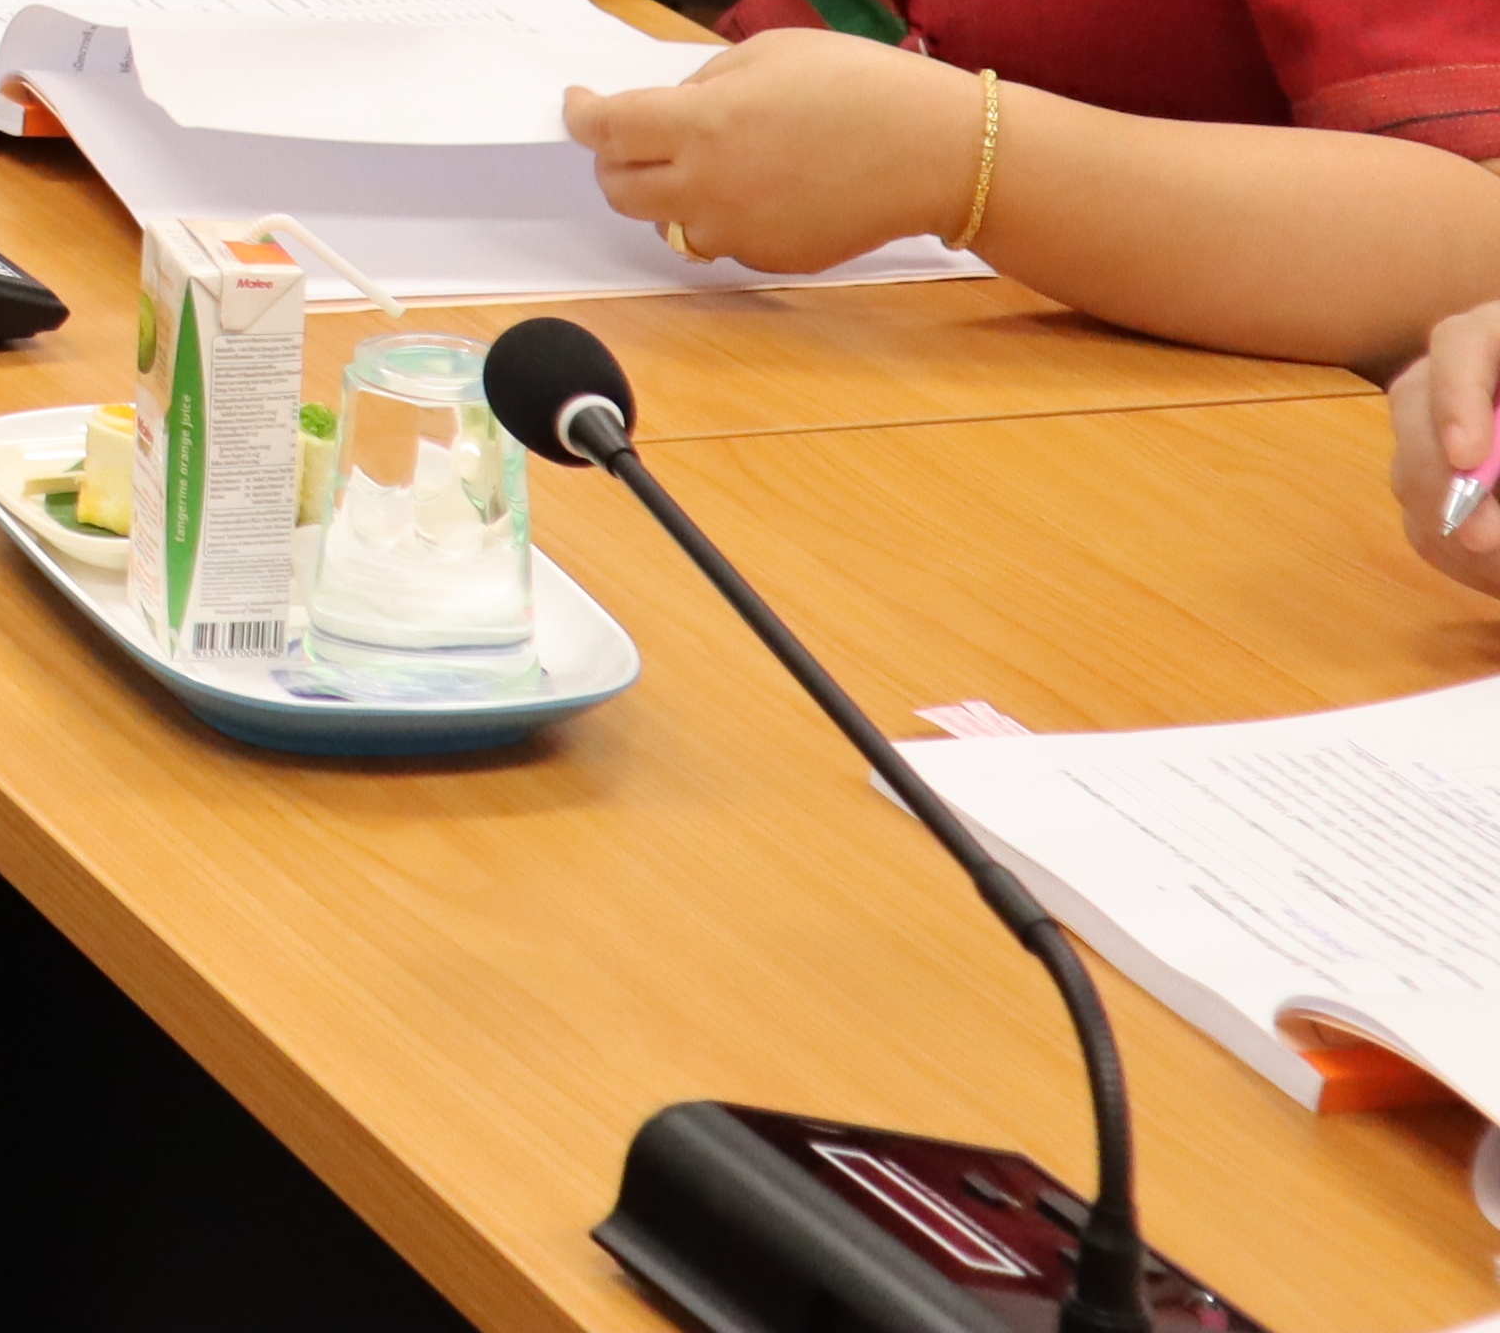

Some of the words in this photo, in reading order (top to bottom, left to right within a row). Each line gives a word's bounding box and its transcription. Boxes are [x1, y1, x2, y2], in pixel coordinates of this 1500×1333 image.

[235, 277, 275, 290] Malee
[182, 393, 193, 431] juice
[179, 433, 191, 480] orange
[174, 479, 188, 543] tangerine
